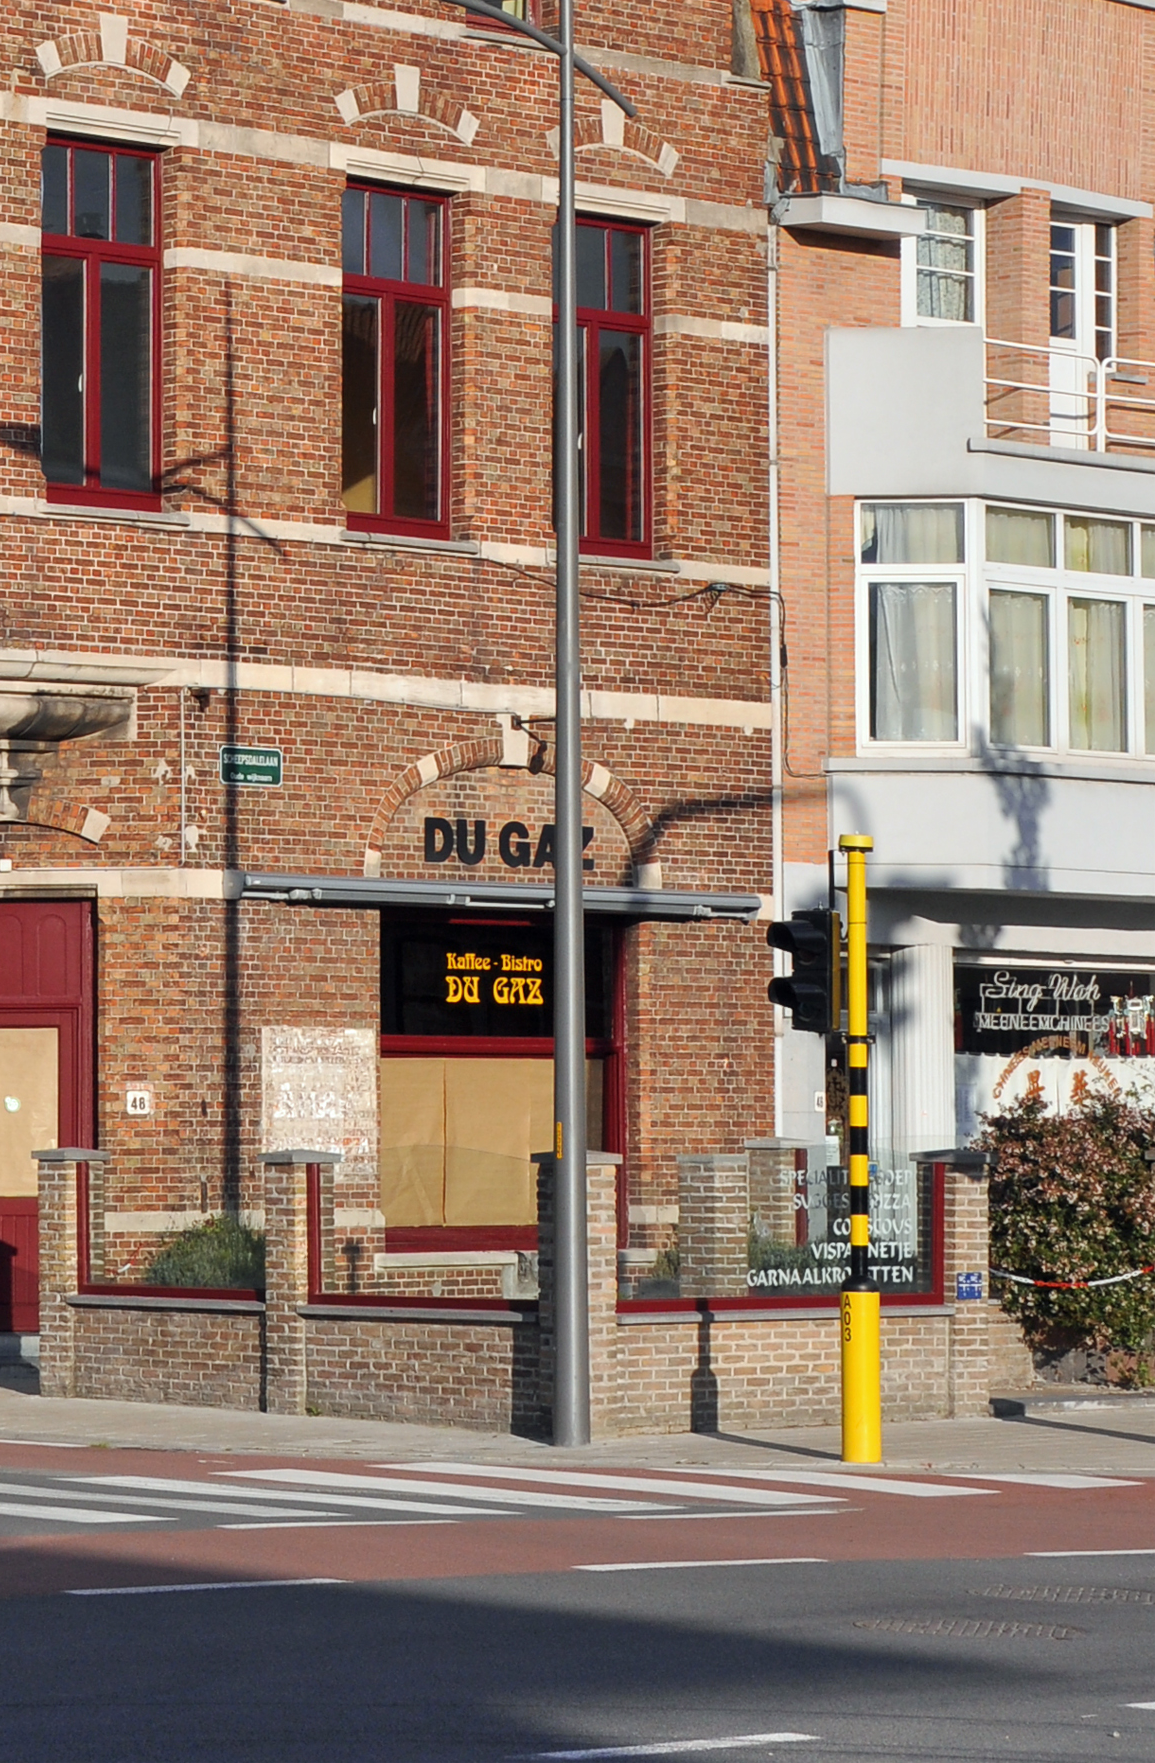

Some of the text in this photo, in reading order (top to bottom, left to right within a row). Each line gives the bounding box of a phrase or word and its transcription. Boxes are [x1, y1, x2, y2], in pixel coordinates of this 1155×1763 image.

[424, 816, 486, 866] DU
[446, 952, 491, 970] Kaffee
[501, 954, 543, 972] Bistro
[445, 976, 544, 1005] DU GAZ
[985, 971, 1101, 1012] Sing Wah
[131, 1096, 146, 1110] 48
[833, 1218, 913, 1236] COSCOUS
[811, 1242, 914, 1261] VISPANETJE
[747, 1266, 914, 1287] GARNAALKROTTEN
[844, 1294, 852, 1342] A03
